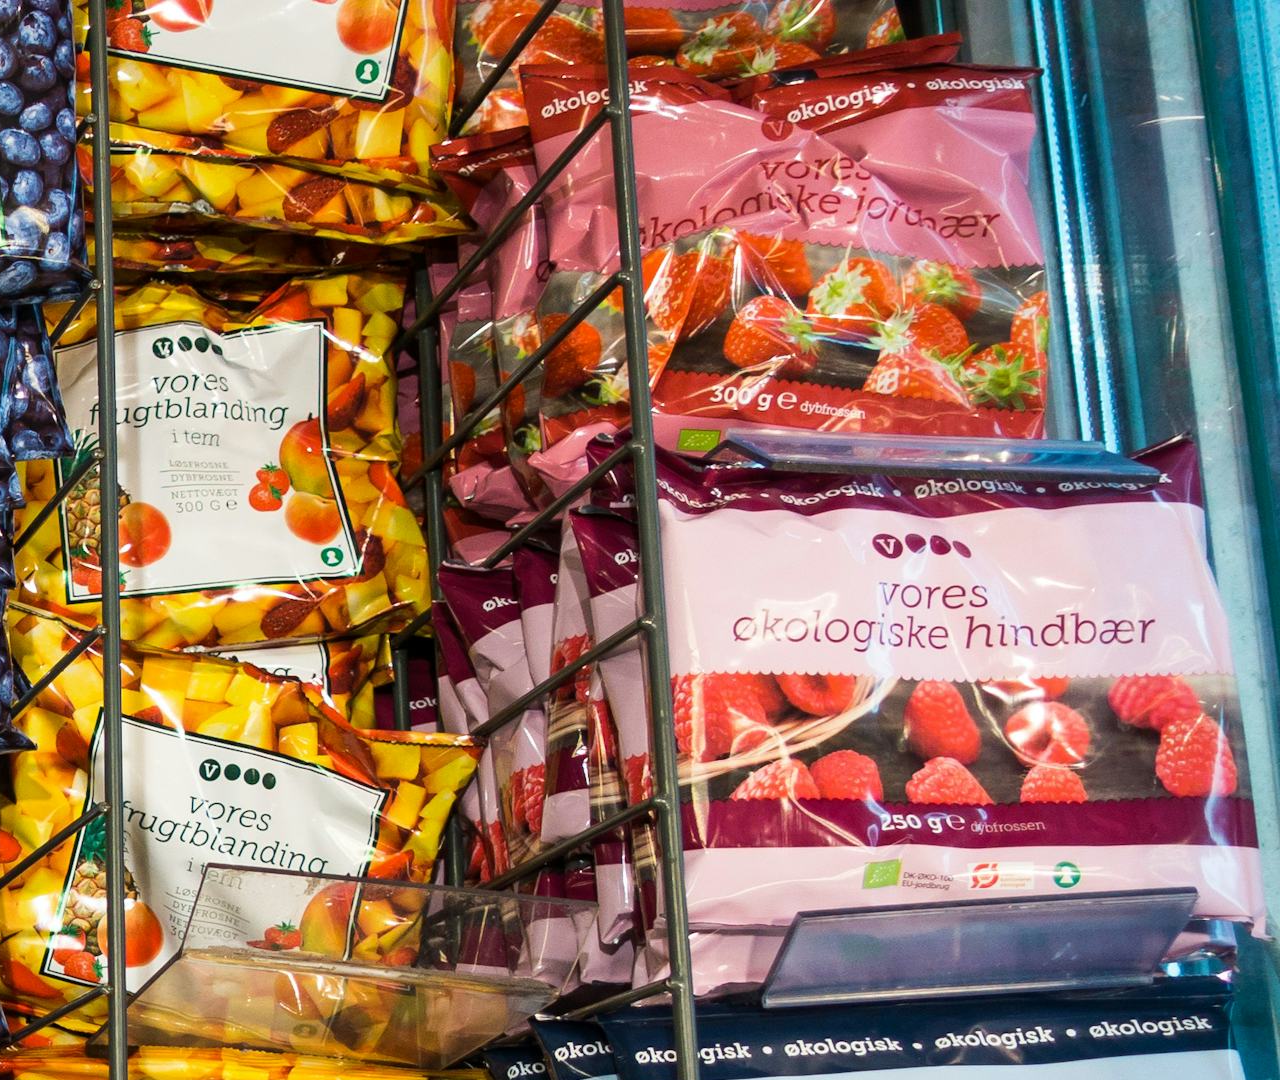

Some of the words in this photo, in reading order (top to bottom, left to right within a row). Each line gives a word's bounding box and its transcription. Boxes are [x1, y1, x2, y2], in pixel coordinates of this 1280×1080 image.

[541, 80, 648, 119] økologsk
[787, 80, 899, 123] økologisk
[925, 77, 1025, 91] økologisk
[152, 371, 230, 394] vores
[89, 396, 289, 431] fugtblanding
[709, 384, 752, 406] 300
[798, 402, 866, 422] dybfrossen
[171, 489, 238, 499] NETTOVÆGT
[914, 478, 1027, 500] økologisk
[176, 501, 203, 513] 300
[878, 580, 989, 610] vores
[732, 609, 949, 653] økologiske
[964, 612, 1156, 650] hindbær
[187, 795, 273, 833] vores
[881, 812, 922, 832] 250
[970, 816, 1046, 834] dybfrossen
[784, 1034, 901, 1058] økologisk
[934, 1025, 1056, 1051] økologisk
[1089, 1014, 1213, 1039] økologisk
